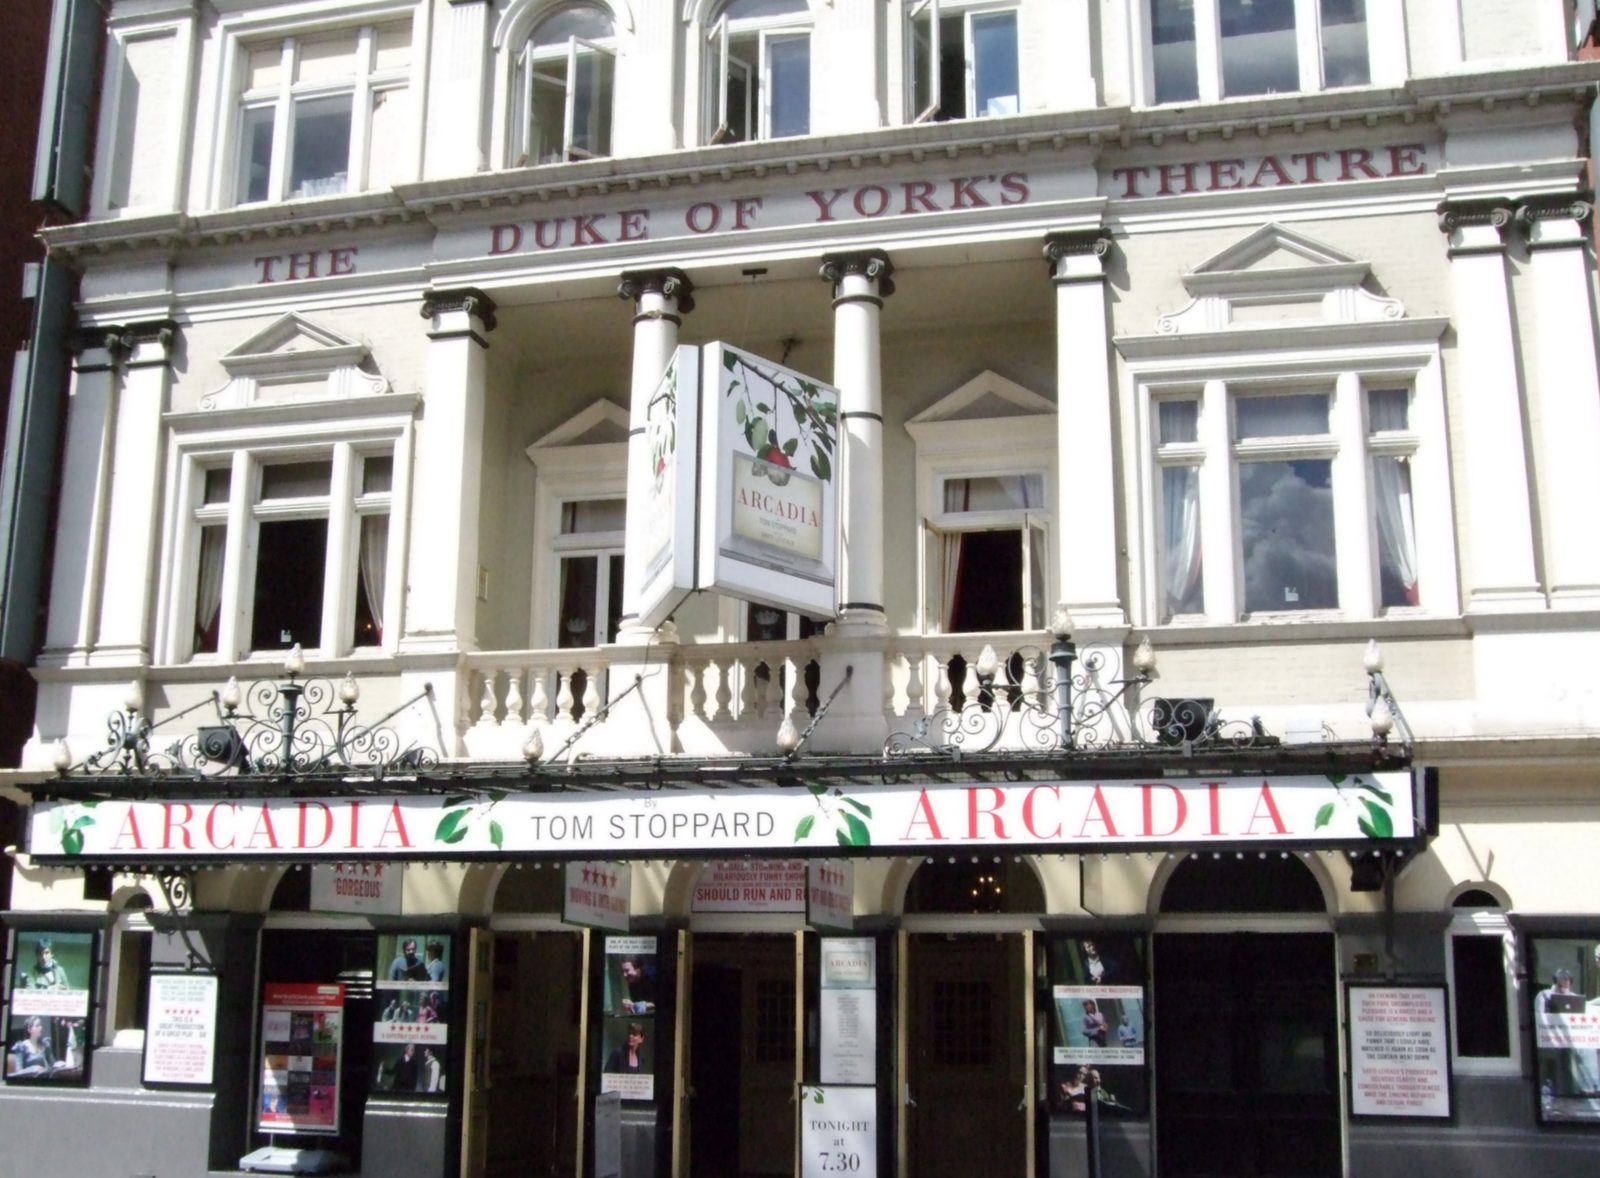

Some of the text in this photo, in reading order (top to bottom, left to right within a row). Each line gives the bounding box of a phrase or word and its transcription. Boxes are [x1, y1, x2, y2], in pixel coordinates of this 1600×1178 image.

[254, 143, 1427, 284] THE DUKE OF YORK'S THEATRE
[738, 488, 819, 527] ARCADIA
[109, 799, 416, 849] ARCADIA
[898, 780, 1295, 841] ARCADIA
[530, 812, 774, 840] TOM STOPPARD
[697, 888, 739, 901] SHOULD
[743, 888, 766, 901] RUN
[769, 888, 791, 901] AND
[809, 1120, 870, 1132] TONIGHT
[833, 1136, 844, 1147] at
[818, 1152, 861, 1172] 7.30
